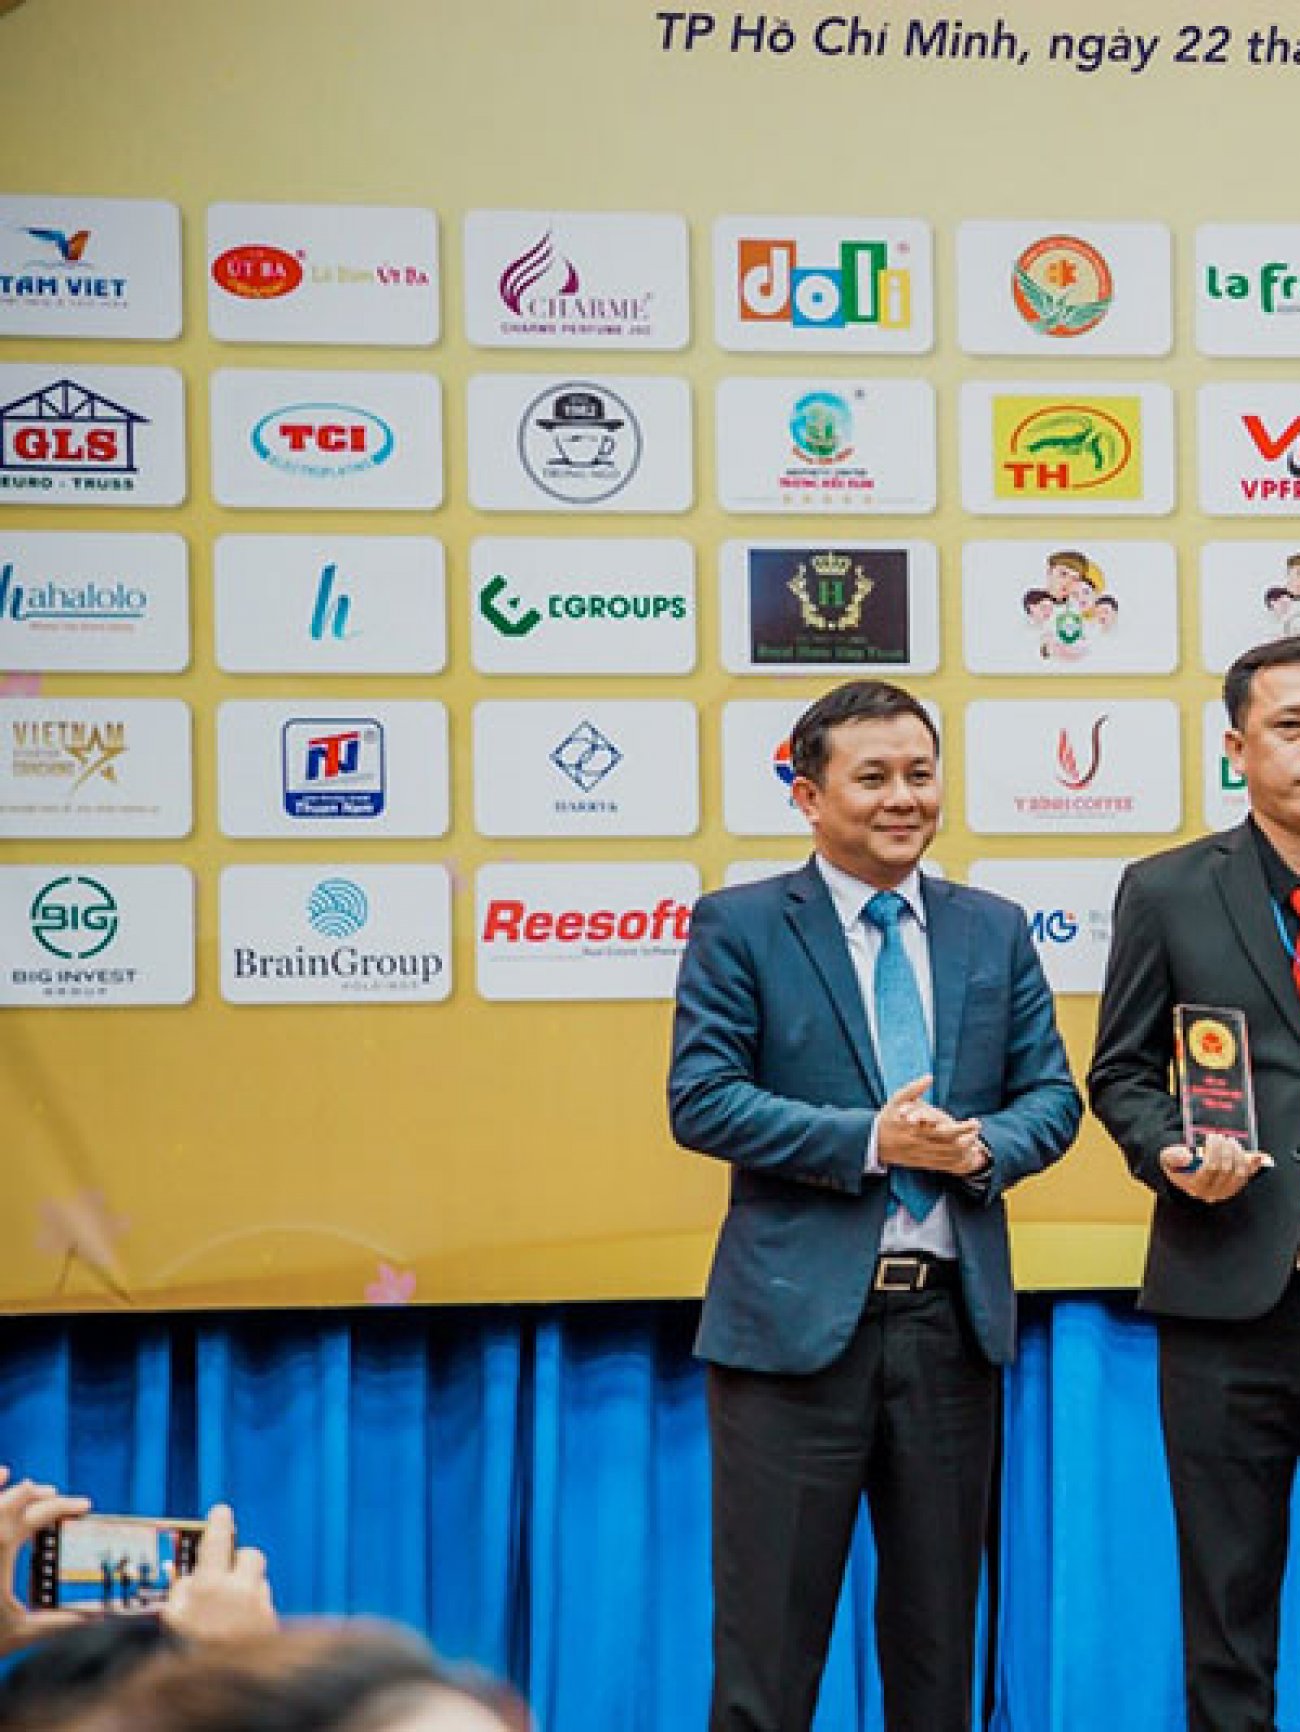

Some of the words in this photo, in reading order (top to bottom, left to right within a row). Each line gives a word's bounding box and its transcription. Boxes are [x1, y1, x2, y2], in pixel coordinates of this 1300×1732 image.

[656, 12, 715, 50] TP
[730, 14, 796, 53] Hồ
[813, 15, 889, 56] Chí
[904, 19, 1029, 65] Minh,
[1049, 28, 1159, 74] ngày
[1174, 25, 1231, 63] 22
[740, 239, 911, 329] doli
[1206, 264, 1250, 299] la
[12, 427, 119, 462] GLS
[279, 425, 367, 453] TCI
[1004, 462, 1069, 490] TH
[40, 905, 110, 931] BIG
[482, 898, 689, 943] Reesoft
[12, 968, 52, 984] BIG
[56, 968, 138, 984] INVEST
[234, 946, 444, 983] BrainGroup
